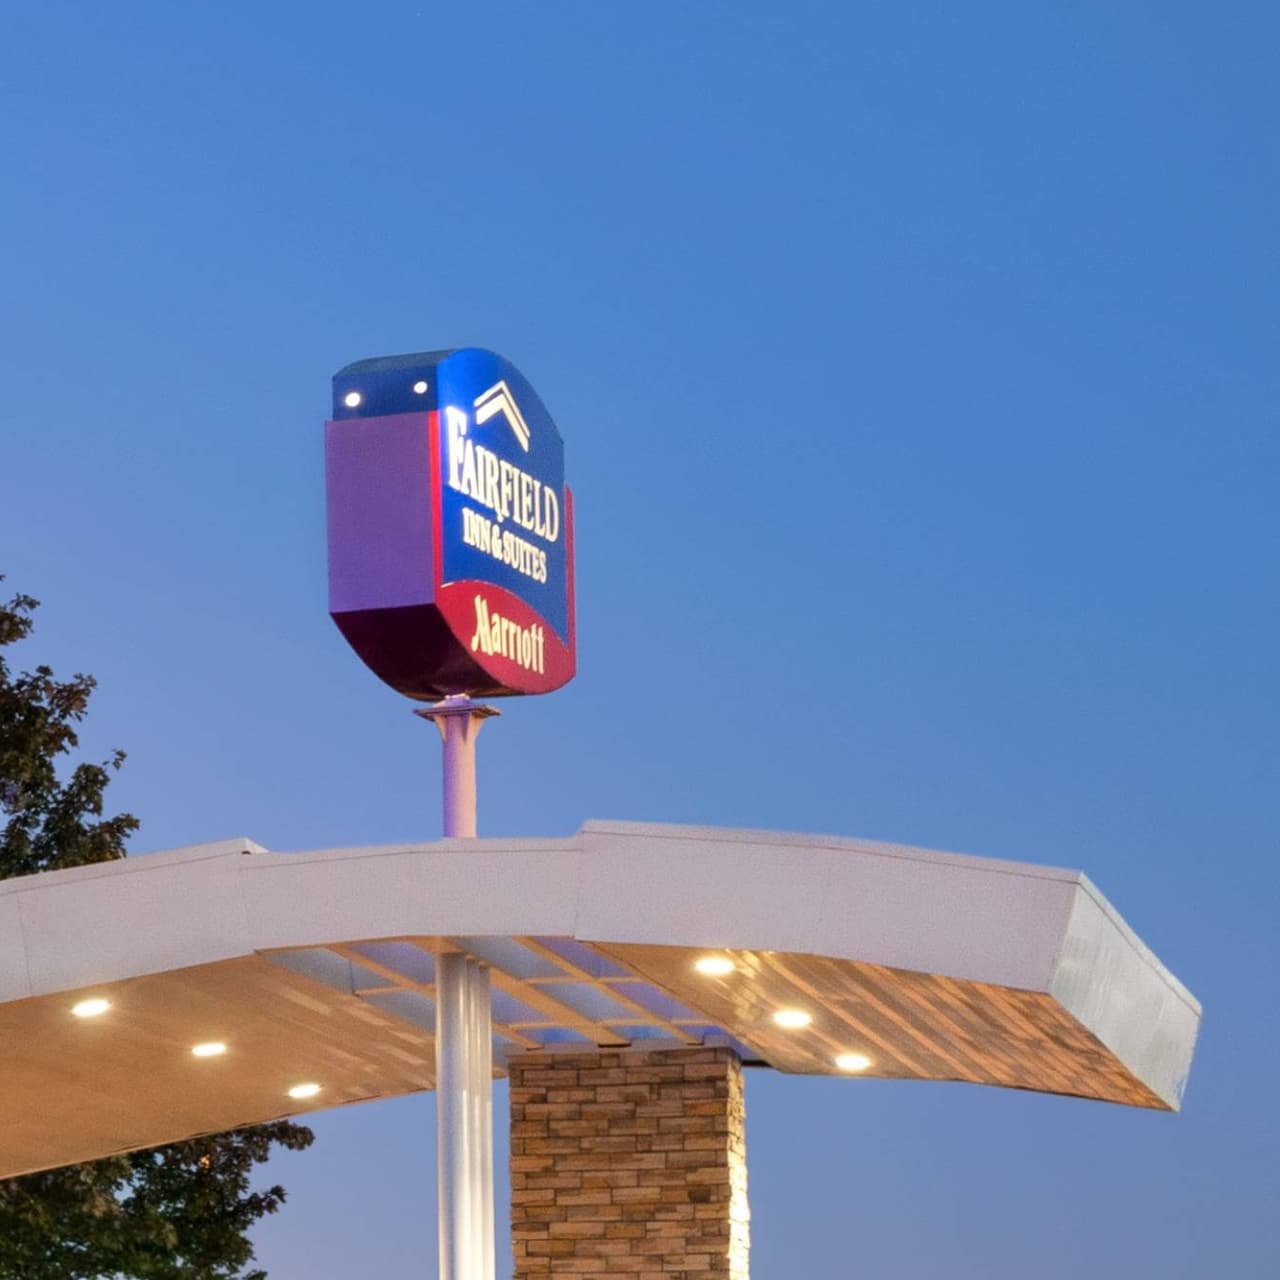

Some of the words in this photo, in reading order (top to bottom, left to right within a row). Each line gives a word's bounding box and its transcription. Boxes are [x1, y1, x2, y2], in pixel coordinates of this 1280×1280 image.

[446, 405, 560, 543] FAIRFIELD
[462, 507, 491, 553] INN
[503, 529, 548, 585] SUITES
[472, 594, 544, 674] Marriott
